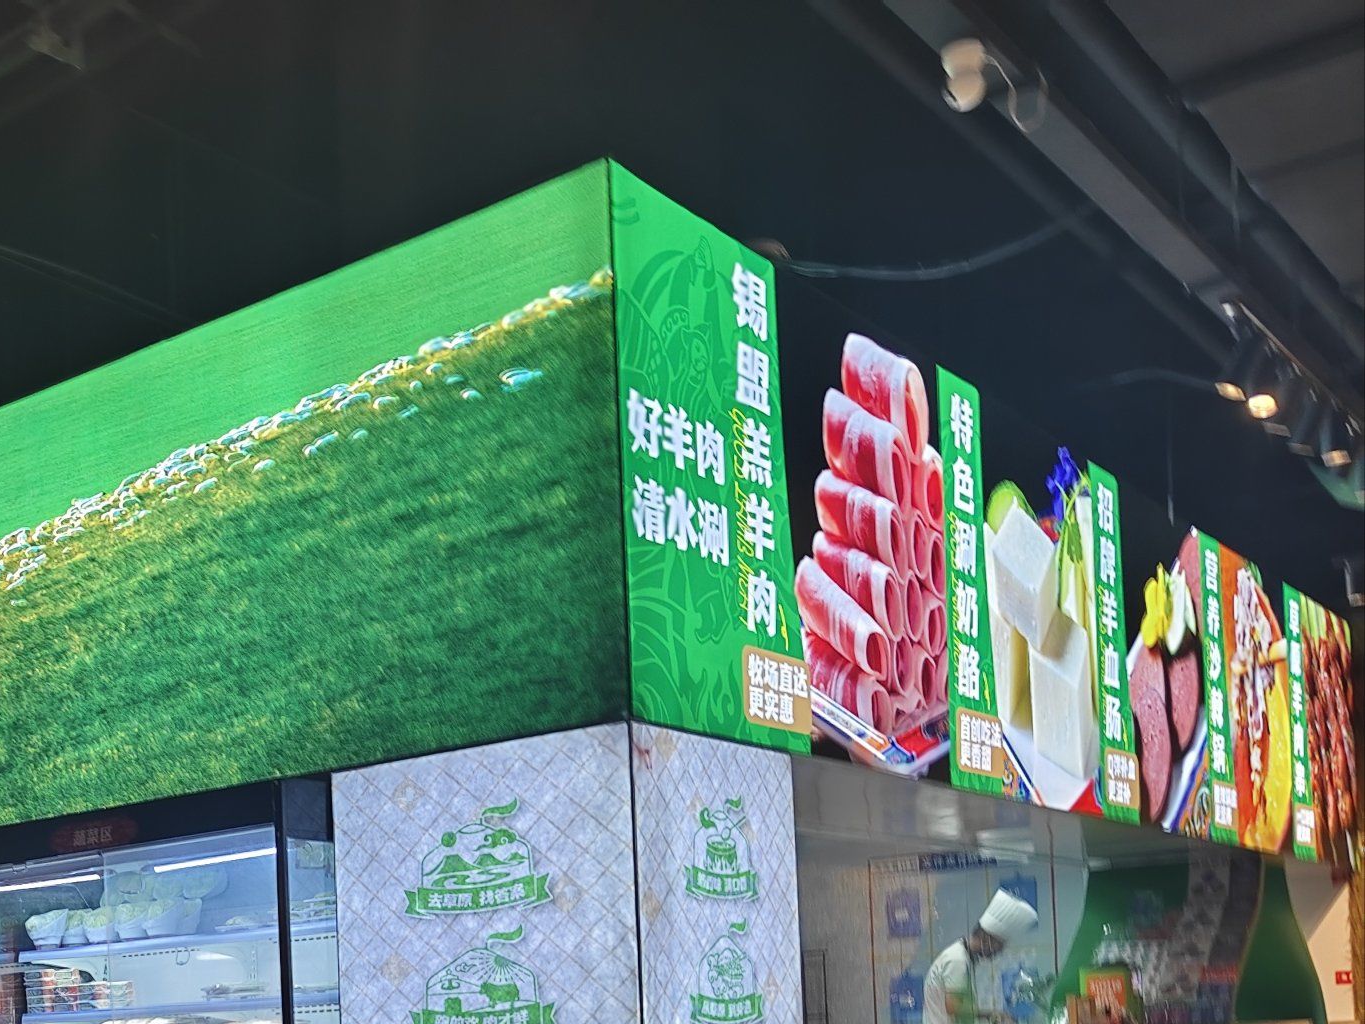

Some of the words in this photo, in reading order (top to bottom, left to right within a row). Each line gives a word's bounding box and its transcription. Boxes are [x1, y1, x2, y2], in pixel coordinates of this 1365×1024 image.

[626, 387, 726, 487] 好羊肉
[731, 262, 778, 639] 锡盟羔羊肉
[632, 480, 731, 567] 清水涮
[950, 392, 981, 701] 特色涮奶酪
[749, 653, 808, 698] 牧场直达
[749, 688, 794, 725] 更实惠
